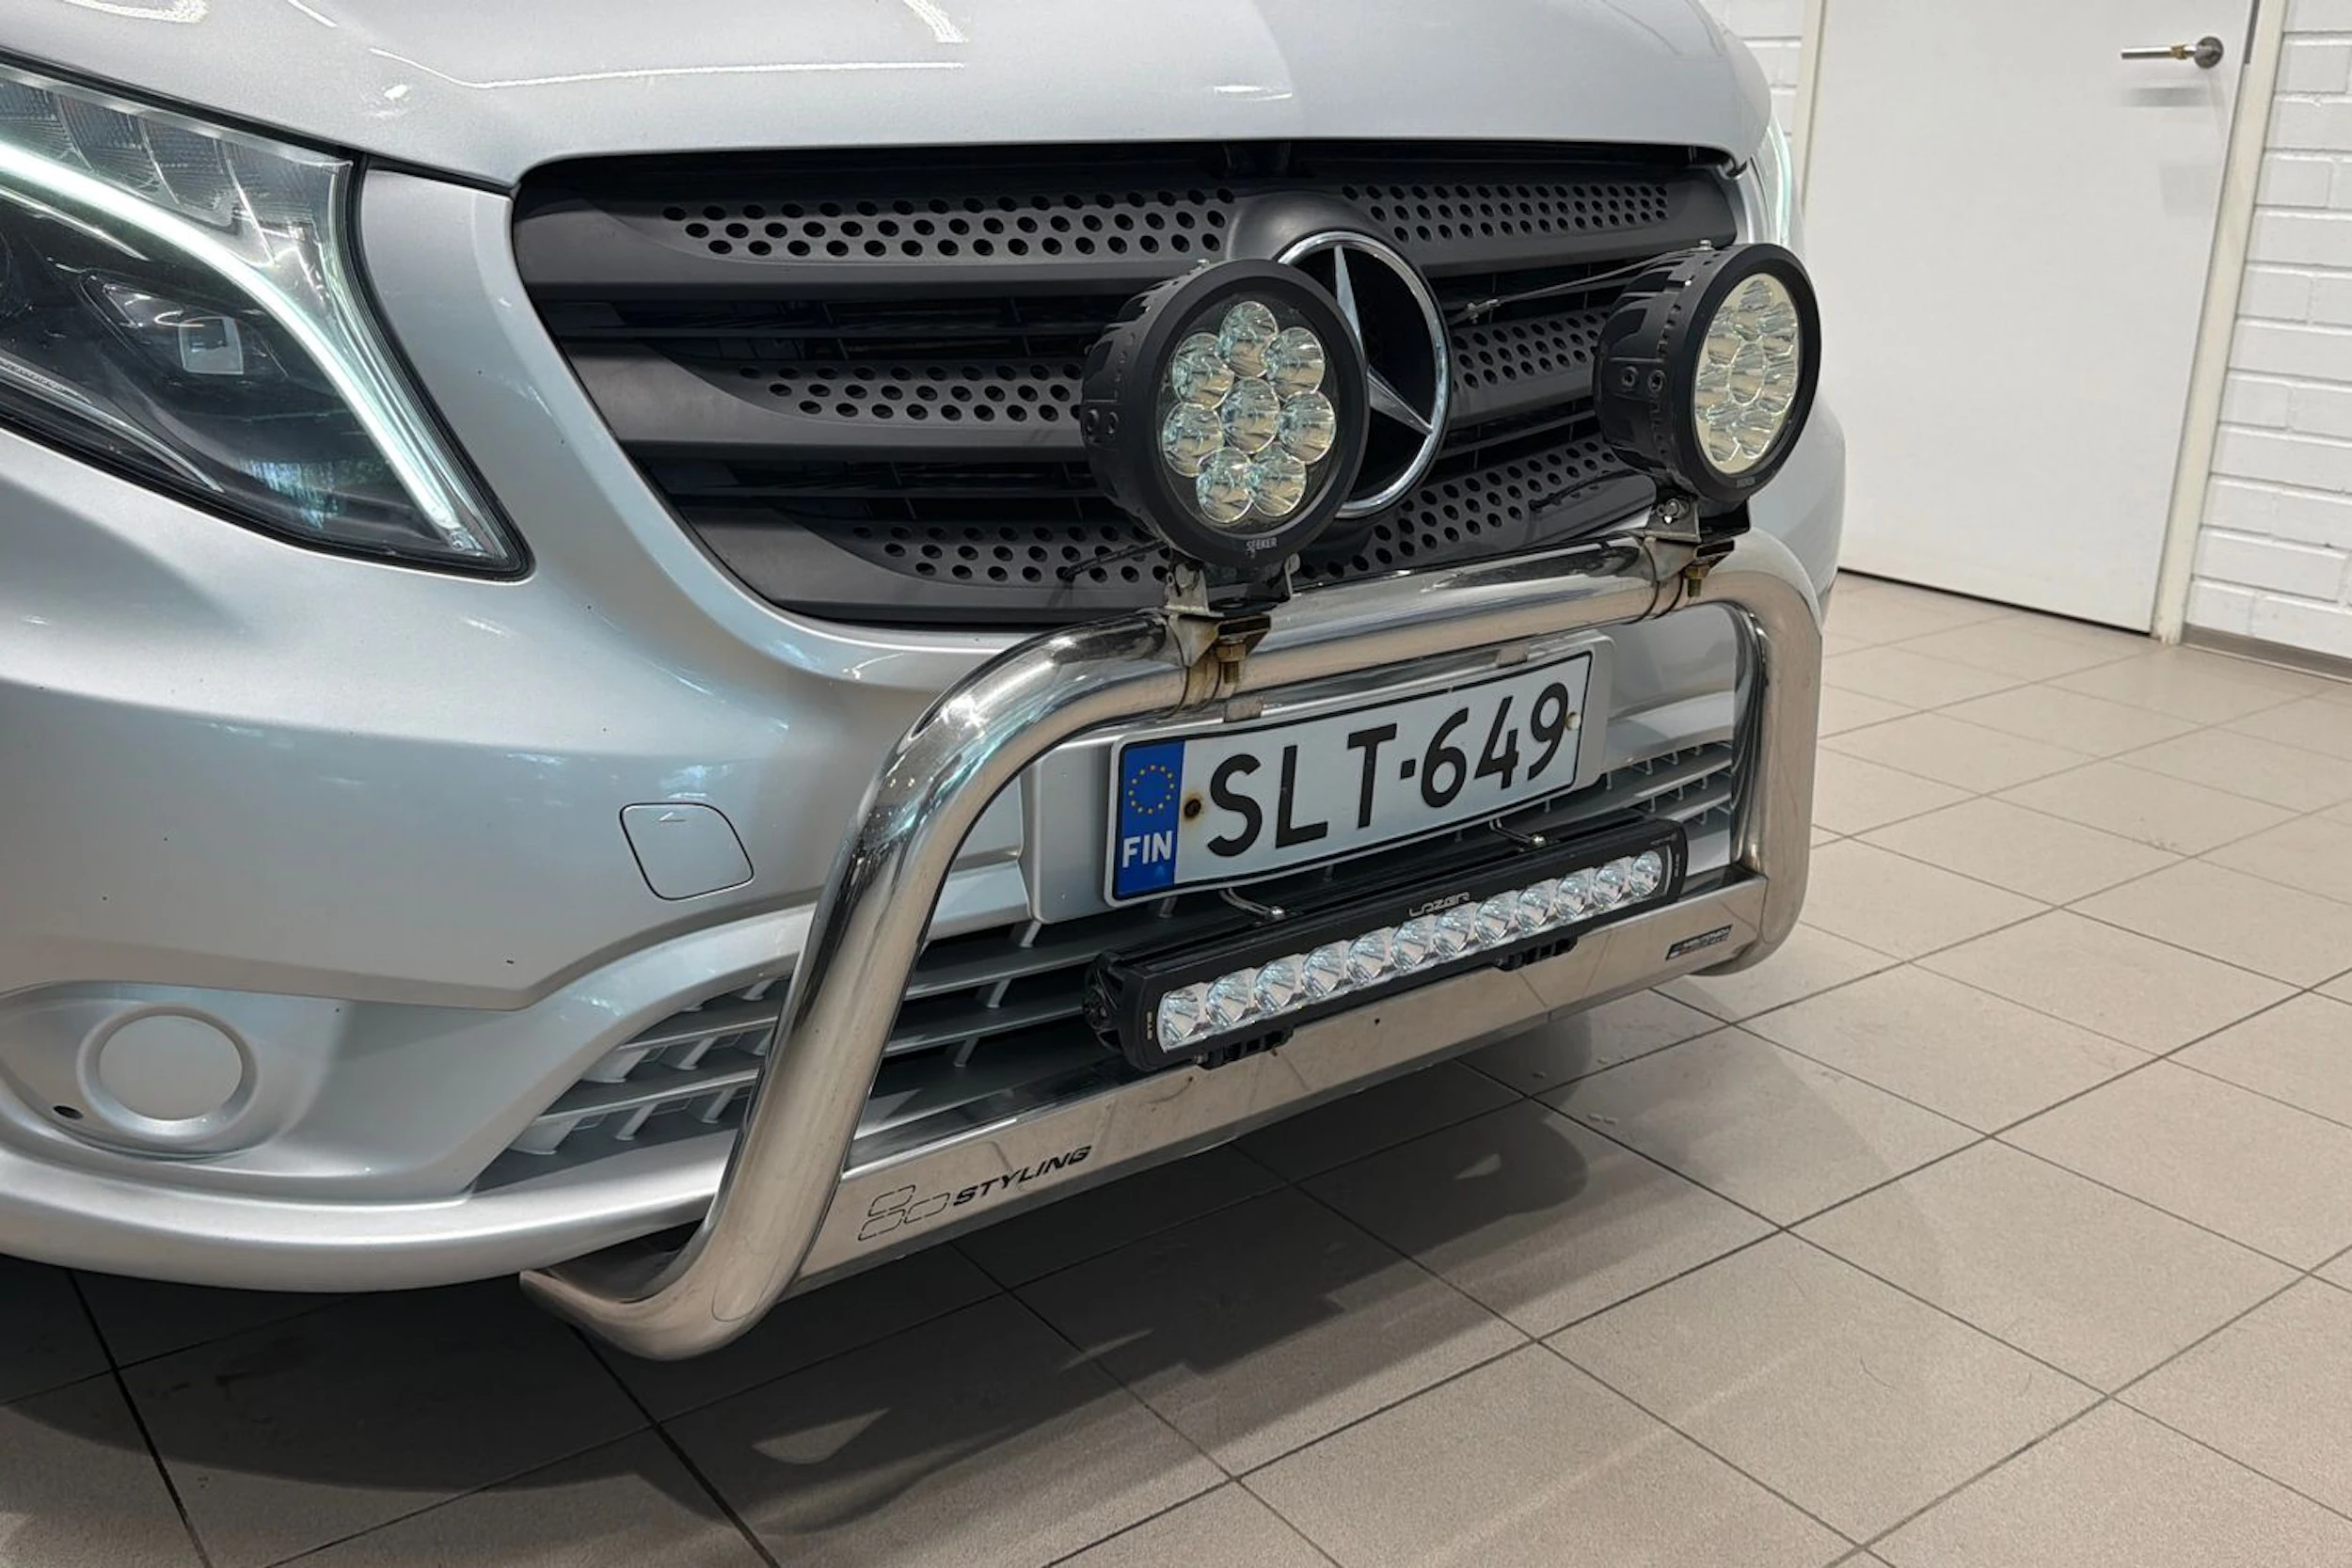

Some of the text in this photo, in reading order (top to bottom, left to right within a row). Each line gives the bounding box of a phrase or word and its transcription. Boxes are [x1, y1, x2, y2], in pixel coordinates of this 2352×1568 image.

[1207, 682, 1569, 857] SLT-649
[1121, 830, 1173, 869] FIN
[953, 1145, 1091, 1207] STYLING
